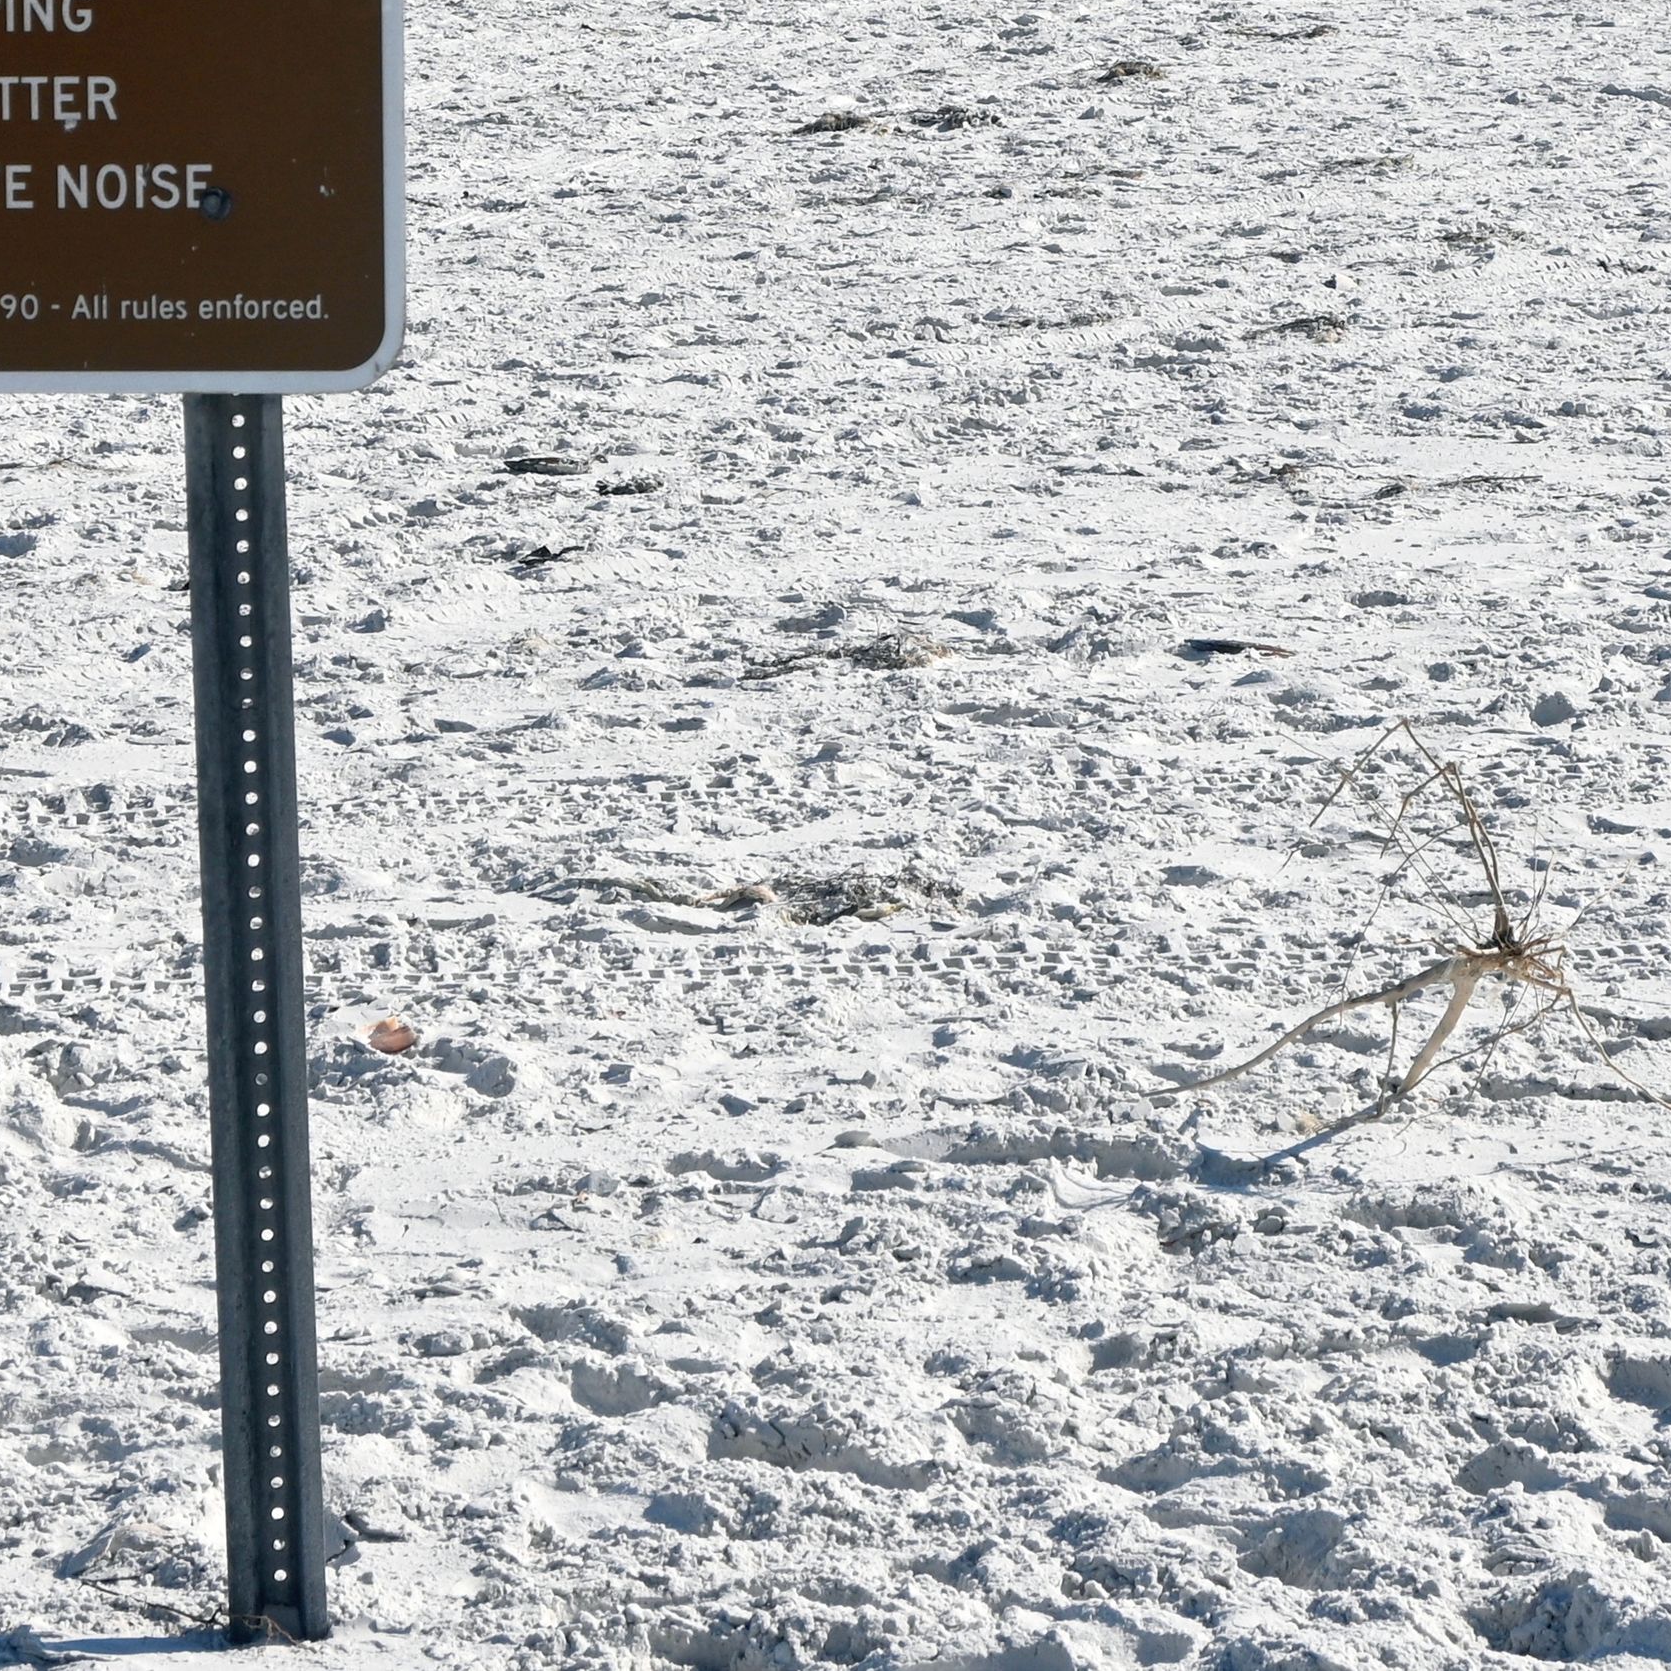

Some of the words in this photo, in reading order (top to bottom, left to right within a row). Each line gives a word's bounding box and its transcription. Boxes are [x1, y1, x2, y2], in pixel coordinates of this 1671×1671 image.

[57, 163, 213, 209] NOISE
[0, 294, 39, 320] 90
[71, 294, 108, 319] All
[121, 295, 188, 320] rules
[199, 293, 329, 320] enforced.
